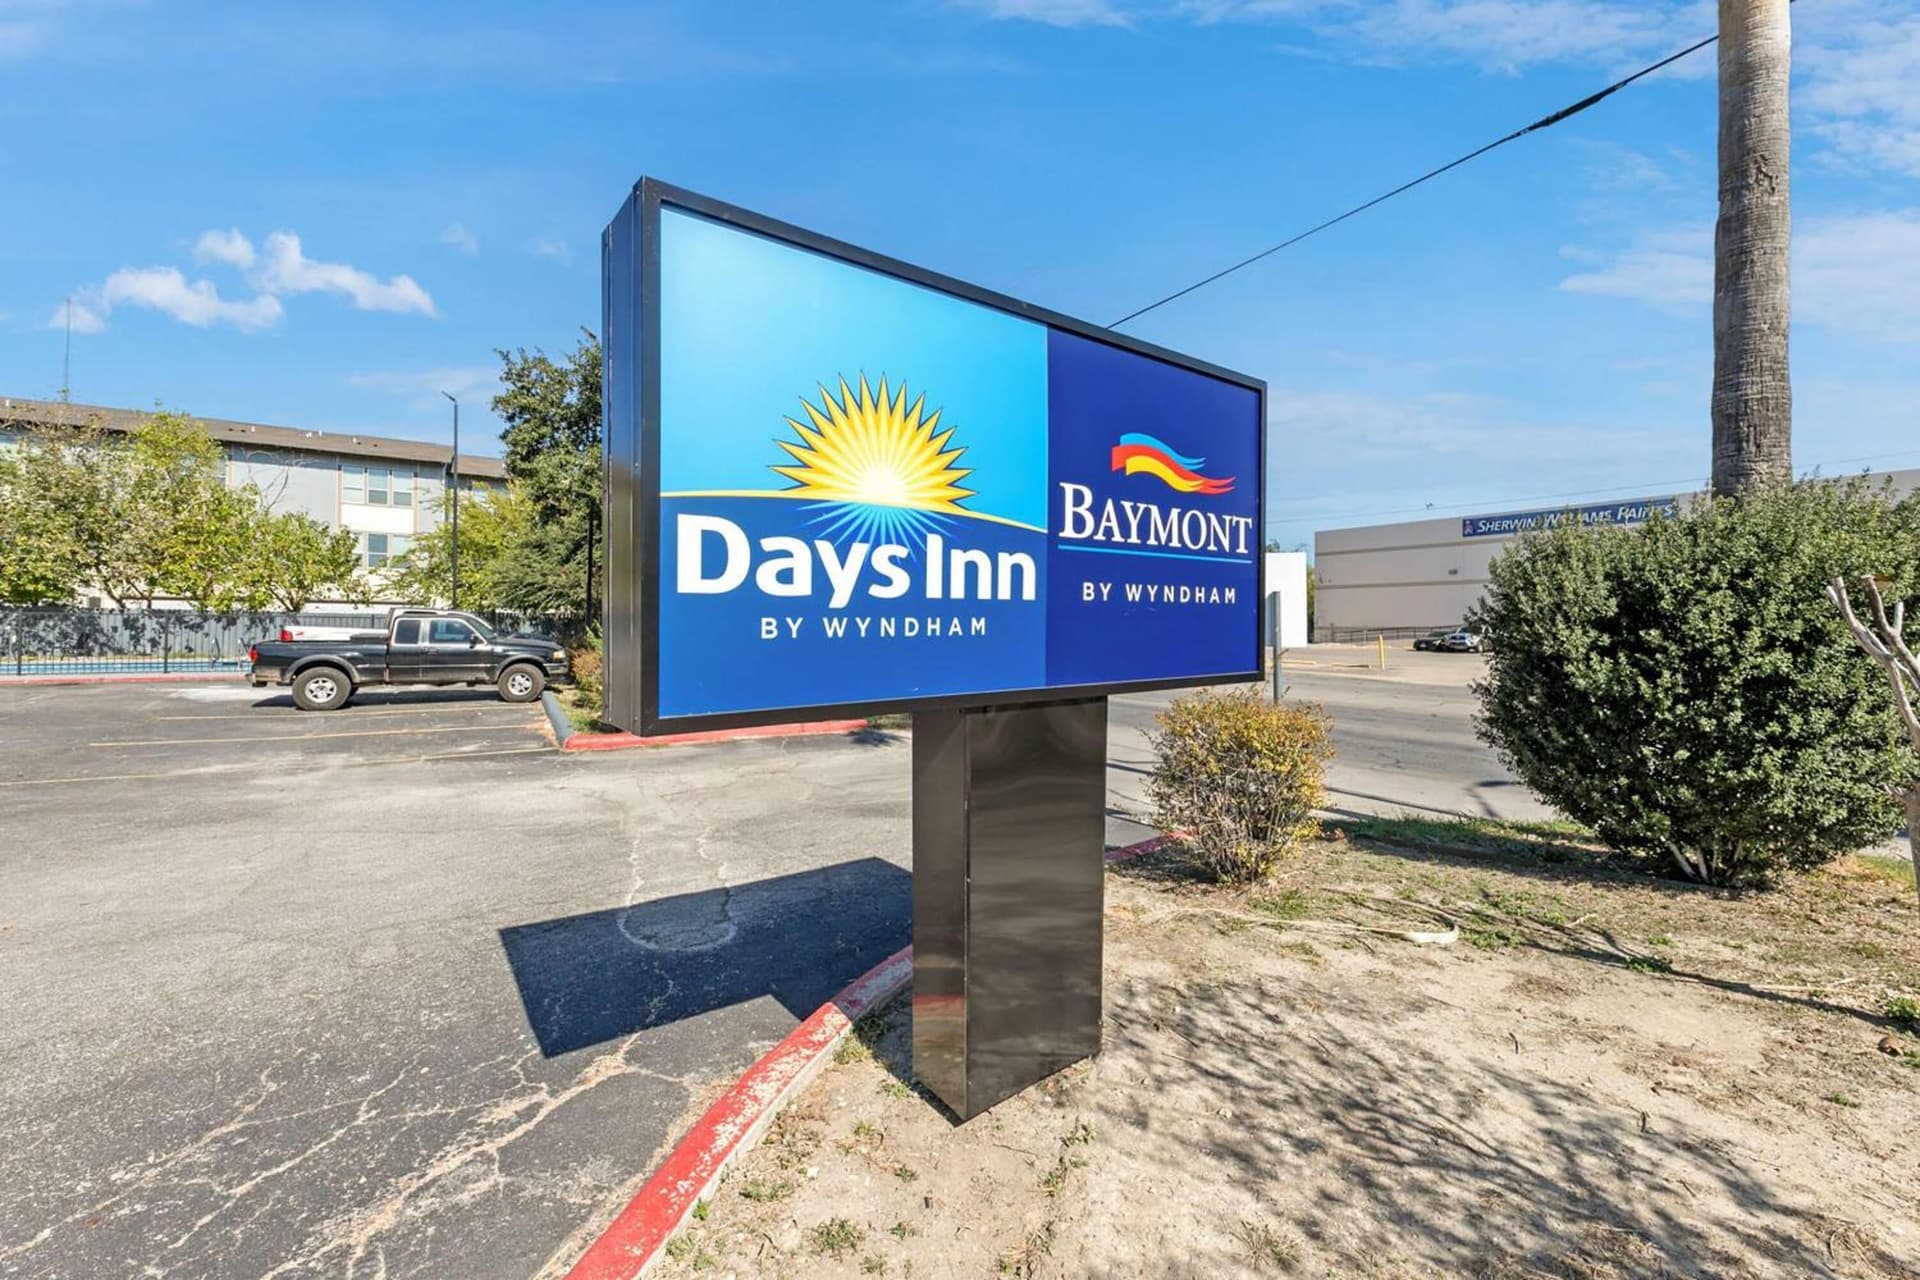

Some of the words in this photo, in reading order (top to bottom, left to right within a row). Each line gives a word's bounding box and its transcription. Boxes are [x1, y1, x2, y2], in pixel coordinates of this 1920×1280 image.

[1058, 482, 1253, 554] BAYMONT
[1477, 518, 1536, 533] SHERWIN
[1617, 504, 1674, 521] PAINS
[676, 513, 912, 608] Days
[925, 532, 1037, 600] Inn
[1083, 582, 1112, 601] BY
[1126, 584, 1236, 604] WYNDHAM
[760, 616, 804, 640] BY
[823, 616, 988, 638] WYNDHAM
